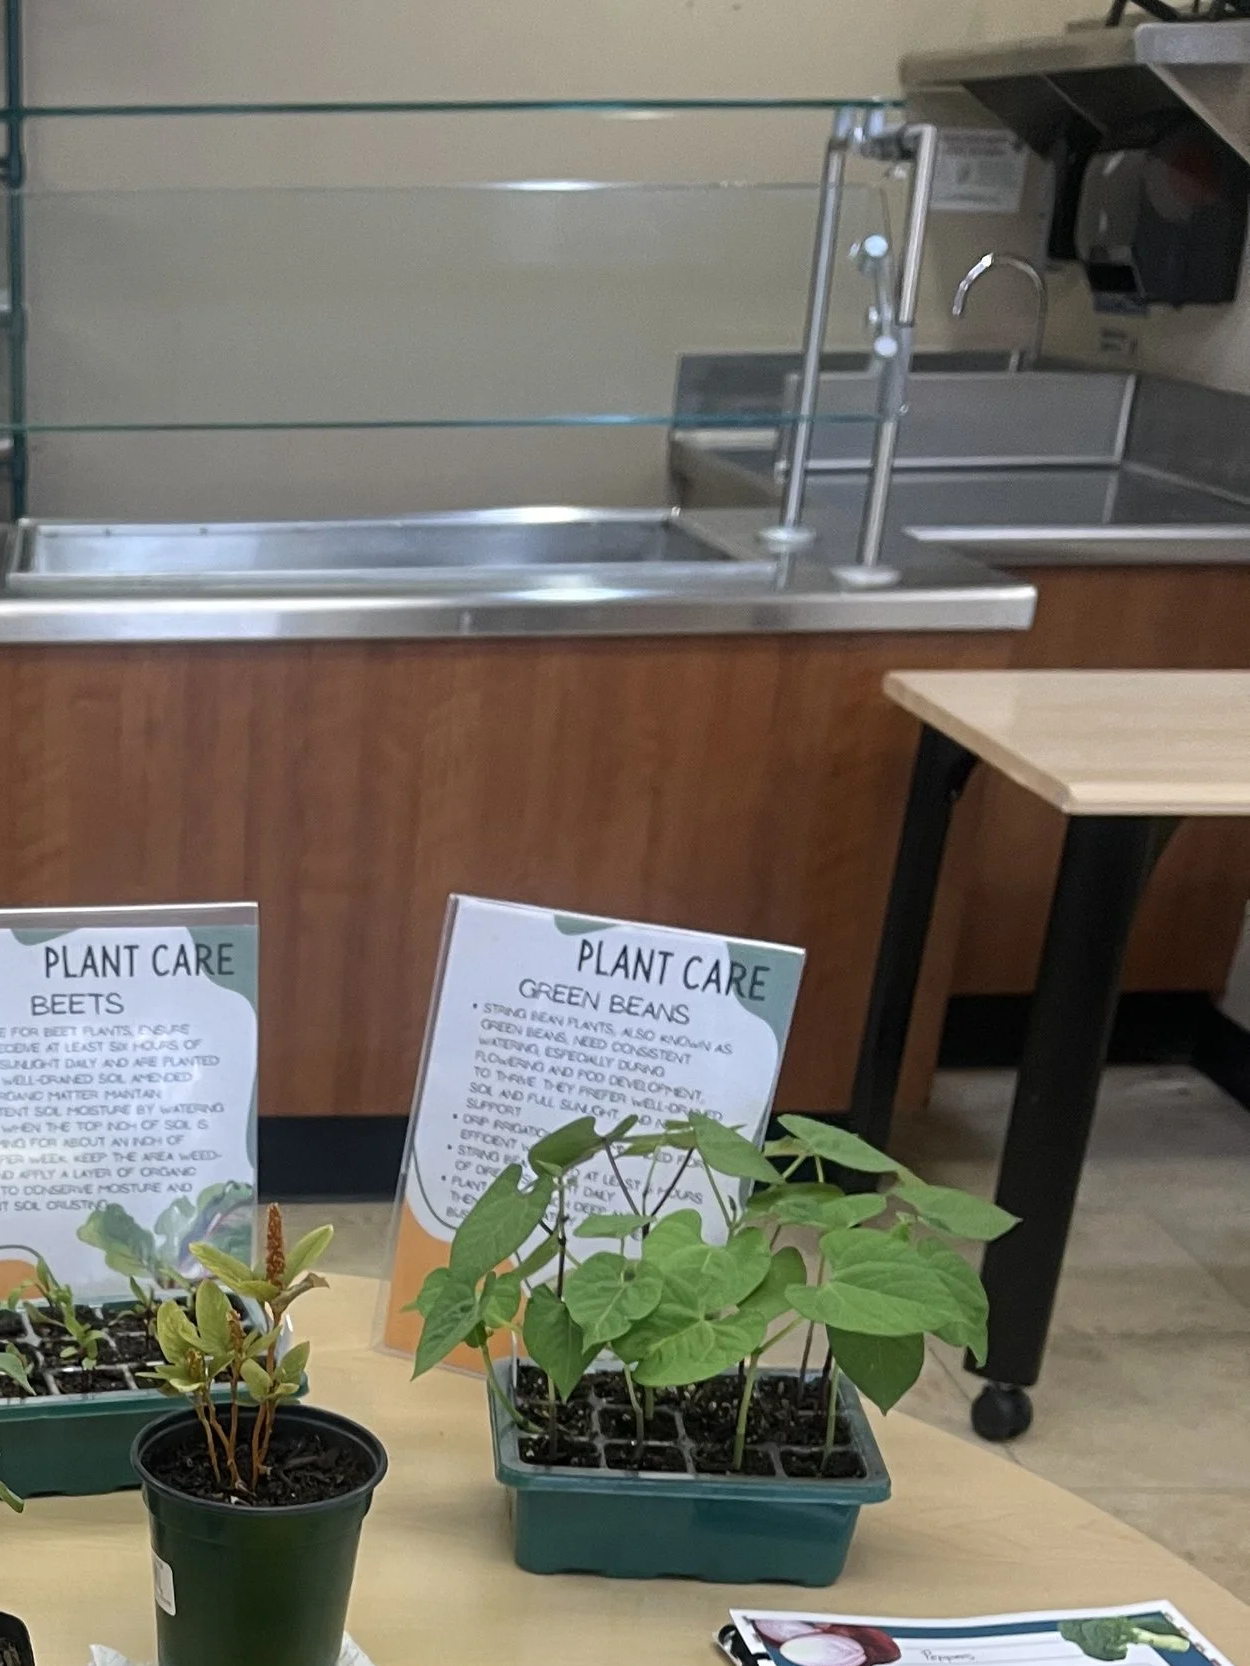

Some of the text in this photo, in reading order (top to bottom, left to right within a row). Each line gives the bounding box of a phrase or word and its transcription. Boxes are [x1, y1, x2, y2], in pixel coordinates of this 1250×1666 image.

[44, 943, 235, 978] PLANT CARE
[577, 939, 770, 1001] PLANT CARE
[30, 992, 125, 1016] BEETS
[518, 979, 691, 1025] GREEN BEANS
[10, 1026, 38, 1037] FOR
[44, 1026, 76, 1036] BEET
[479, 1018, 523, 1036] GREEN
[572, 1034, 608, 1050] NEED
[622, 1025, 655, 1041] ALSO
[659, 1031, 711, 1050] KNOWN
[714, 1040, 734, 1054] AS
[46, 1042, 59, 1052] AT
[65, 1041, 103, 1052] LEAST
[65, 1057, 96, 1068] DAILY
[105, 1057, 128, 1067] AND
[162, 1055, 220, 1066] PLANTED
[617, 1057, 665, 1076] DURING
[472, 1066, 491, 1080] TO
[542, 1077, 575, 1094] THEY
[548, 1062, 574, 1077] AND
[577, 1067, 605, 1082] POD
[465, 1097, 521, 1116] SUPPORT
[499, 1087, 524, 1101] AND
[526, 1091, 555, 1107] FULL
[66, 1104, 130, 1115] MOISTURE
[136, 1104, 154, 1114] BY
[160, 1102, 224, 1114] WATERING
[1, 1122, 40, 1133] WHEN
[46, 1121, 70, 1132] THE
[77, 1121, 102, 1131] TOP
[141, 1119, 159, 1130] OF
[30, 1137, 57, 1148] FOR
[64, 1136, 104, 1147] ABOUT
[112, 1136, 128, 1146] AN
[133, 1135, 162, 1146] INCH
[166, 1135, 184, 1145] OF
[0, 1154, 23, 1164] PER
[74, 1152, 107, 1162] KEEP
[112, 1151, 136, 1162] THE
[142, 1151, 173, 1161] AREA
[20, 1169, 55, 1179] APPLY
[62, 1168, 67, 1178] A
[73, 1168, 111, 1178] LAYER
[117, 1167, 134, 1177] OF
[140, 1166, 196, 1177] ORGANIC
[0, 1185, 18, 1195] TO
[98, 1182, 161, 1194] MOISTURE
[166, 1182, 192, 1192] AND
